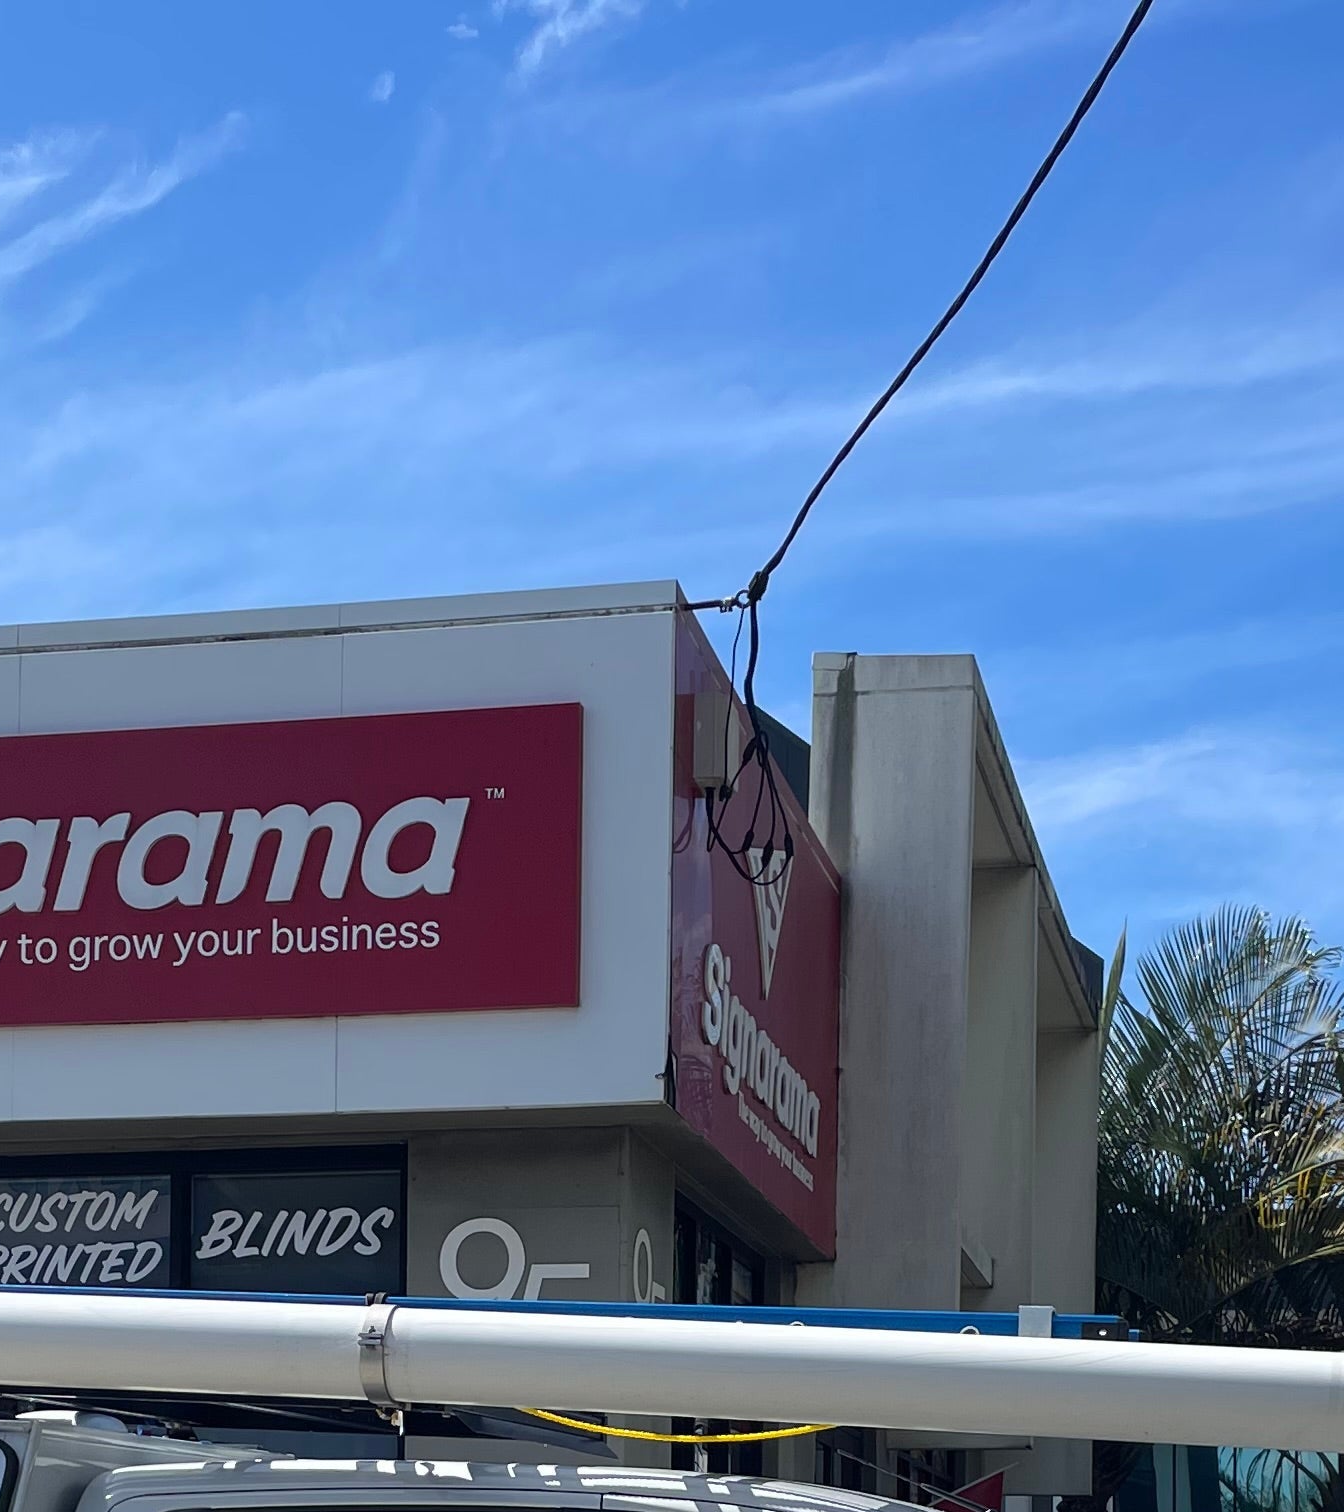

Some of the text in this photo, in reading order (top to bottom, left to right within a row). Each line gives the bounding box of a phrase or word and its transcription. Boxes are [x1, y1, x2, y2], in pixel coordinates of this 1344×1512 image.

[18, 932, 58, 964] to
[69, 932, 164, 968] grow
[173, 928, 261, 966] your
[271, 917, 441, 954] business
[701, 943, 820, 1158] Signarama
[195, 1207, 395, 1259] BLINDS
